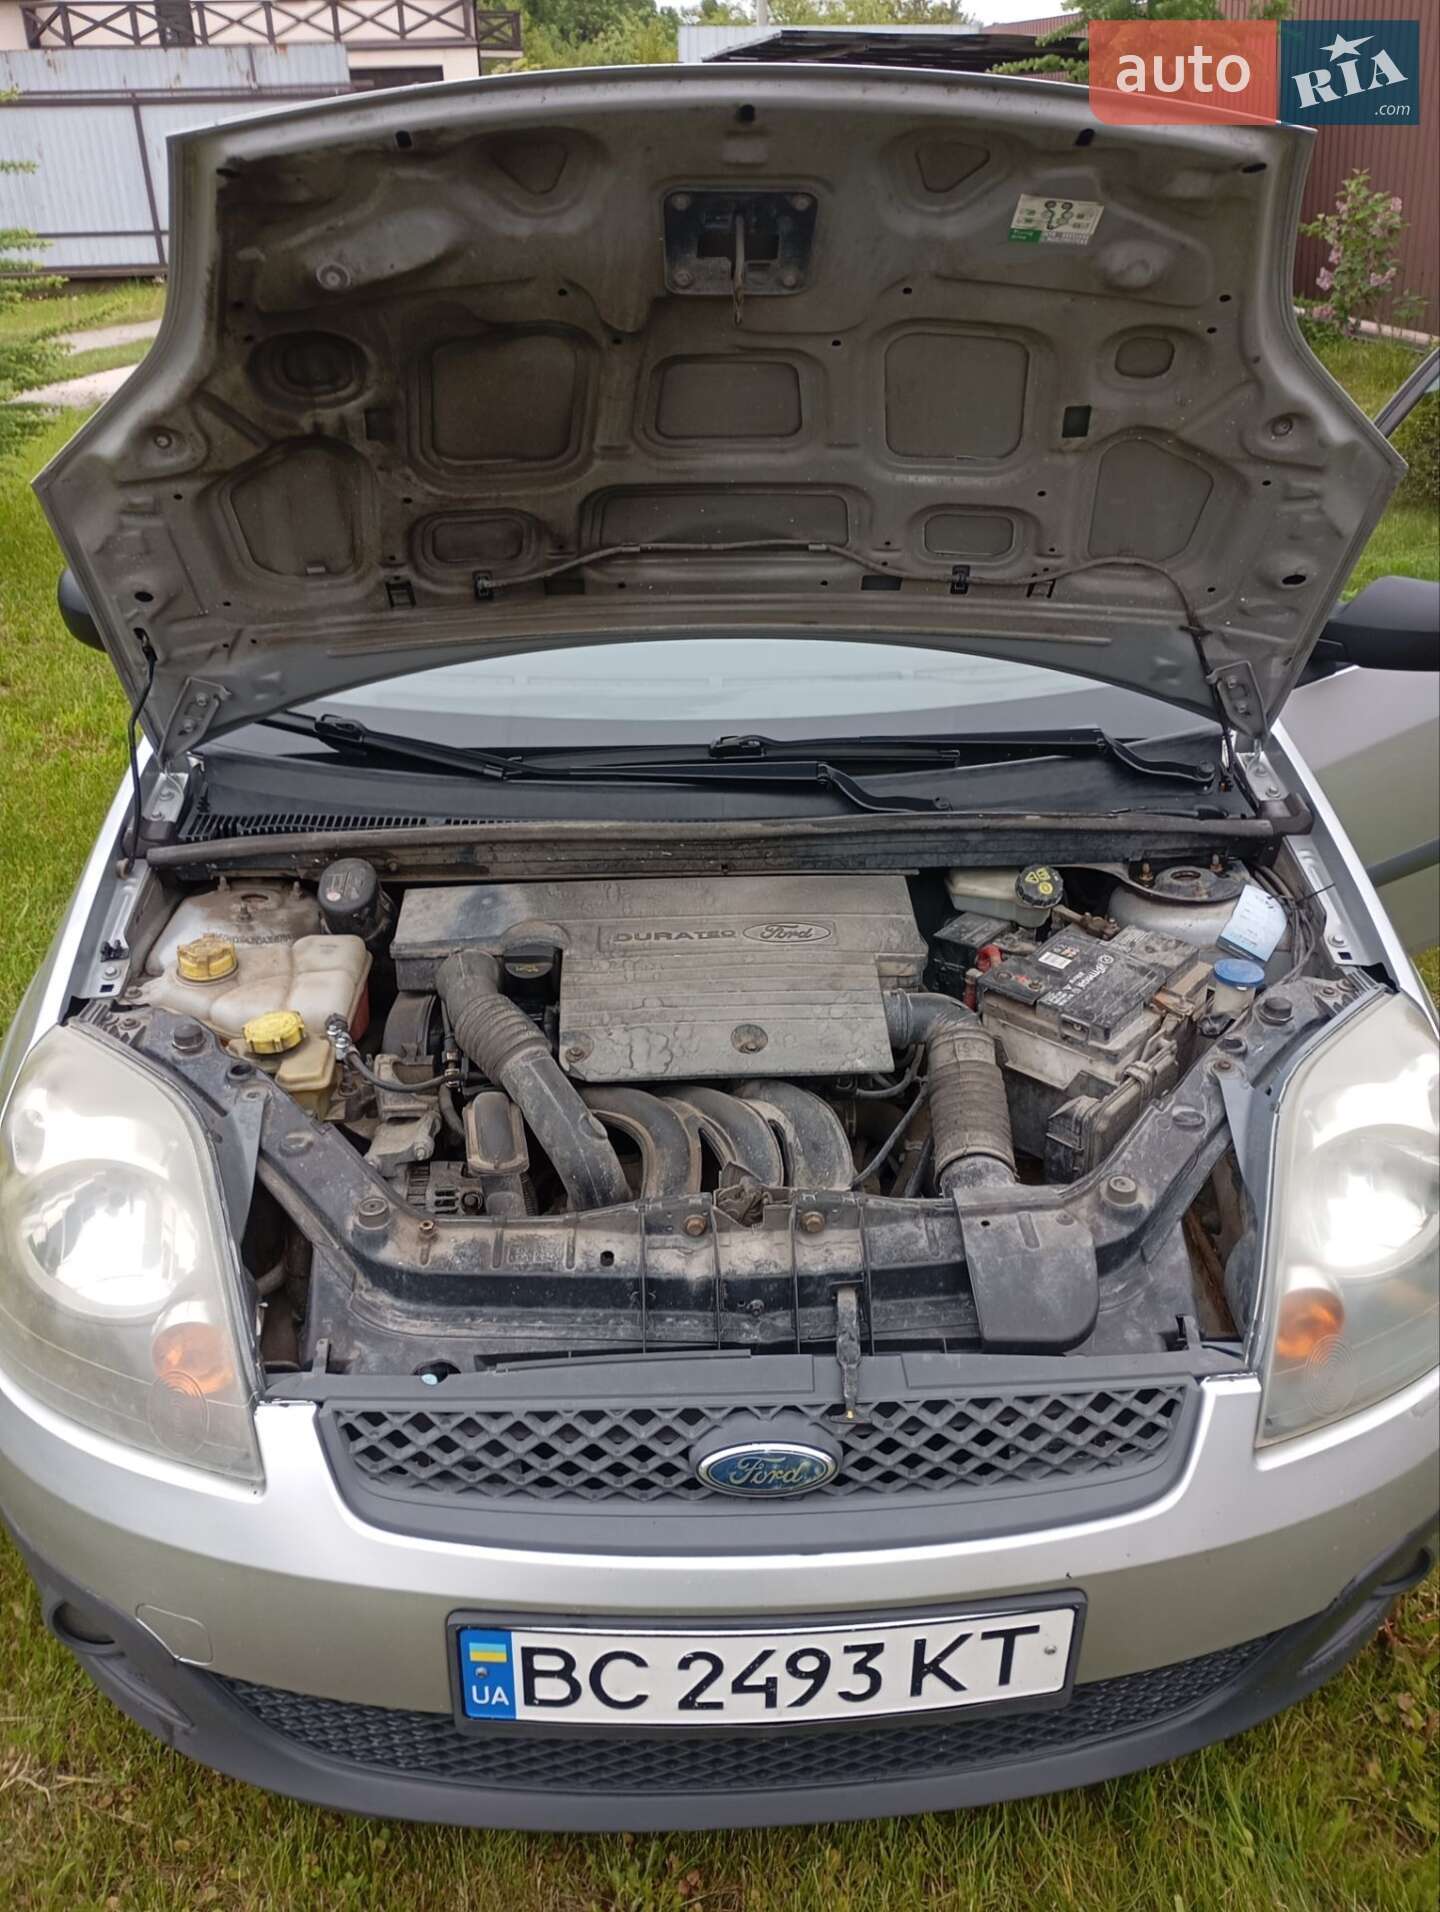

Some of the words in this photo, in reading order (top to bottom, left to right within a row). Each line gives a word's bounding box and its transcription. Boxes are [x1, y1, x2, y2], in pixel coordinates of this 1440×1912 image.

[759, 924, 814, 940] Ford
[728, 1456, 808, 1485] Ford
[520, 1645, 649, 1709] BC
[677, 1642, 886, 1711] 2493
[910, 1624, 1041, 1698] KT
[471, 1684, 510, 1706] UA
